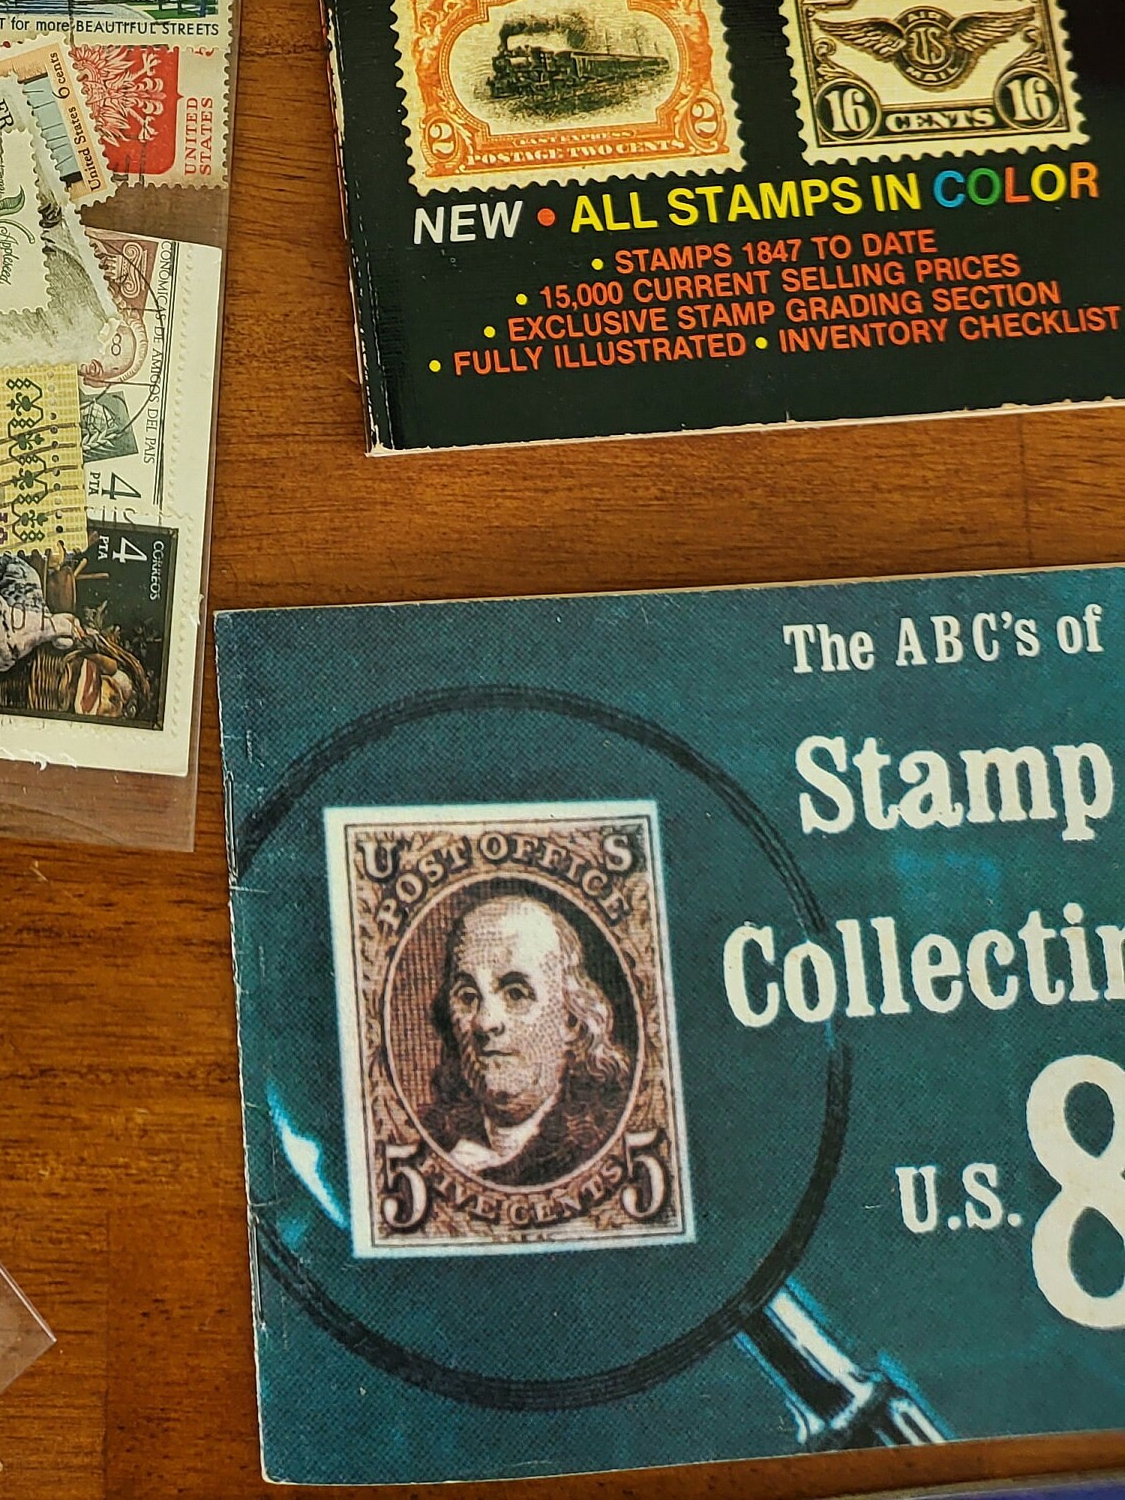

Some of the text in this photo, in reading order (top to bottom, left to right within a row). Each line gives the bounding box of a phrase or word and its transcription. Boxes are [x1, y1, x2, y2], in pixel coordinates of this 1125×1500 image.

[10, 17, 30, 32] for
[35, 20, 70, 33] more
[75, 19, 158, 35] BEAUTIFUL
[161, 21, 220, 37] STREETS
[49, 51, 102, 192] United States 6 cents
[690, 97, 721, 135] 2
[825, 88, 873, 134] 16
[883, 106, 996, 133] CENTS
[1005, 75, 1054, 122] 16
[183, 96, 199, 177] UNITED
[199, 96, 214, 177] STATES
[429, 121, 456, 156] 2
[467, 139, 687, 167] POSTAGE TWO CENTS
[413, 161, 1100, 245] NEW ALL STAMPS IN COLOR
[615, 228, 938, 275] STAMPS 1847 TO DATE
[154, 240, 173, 328] CONOMICAS
[540, 253, 1022, 311] 15,000 CURRENT SELLING PRICES
[507, 280, 1062, 342] EXCLUSIVE STAMP GRADING SECTION
[453, 305, 1122, 376] FULLY ILLUSTRATED INVENTORY CHECKLIST
[148, 348, 164, 403] AMIGOS
[146, 407, 159, 433] DEL
[88, 471, 101, 497] PTA
[101, 472, 142, 501] 4
[97, 534, 110, 561] PTA
[112, 535, 148, 564] 4
[782, 623, 876, 675] The
[1055, 602, 1105, 655] of
[794, 734, 1116, 842] Stamp
[359, 832, 633, 882] U S
[376, 830, 632, 931] POST OFFICE
[722, 901, 1125, 1028] Collecti
[383, 1141, 427, 1229] 5
[621, 1130, 667, 1219] 5
[895, 1162, 1024, 1235] U.S.
